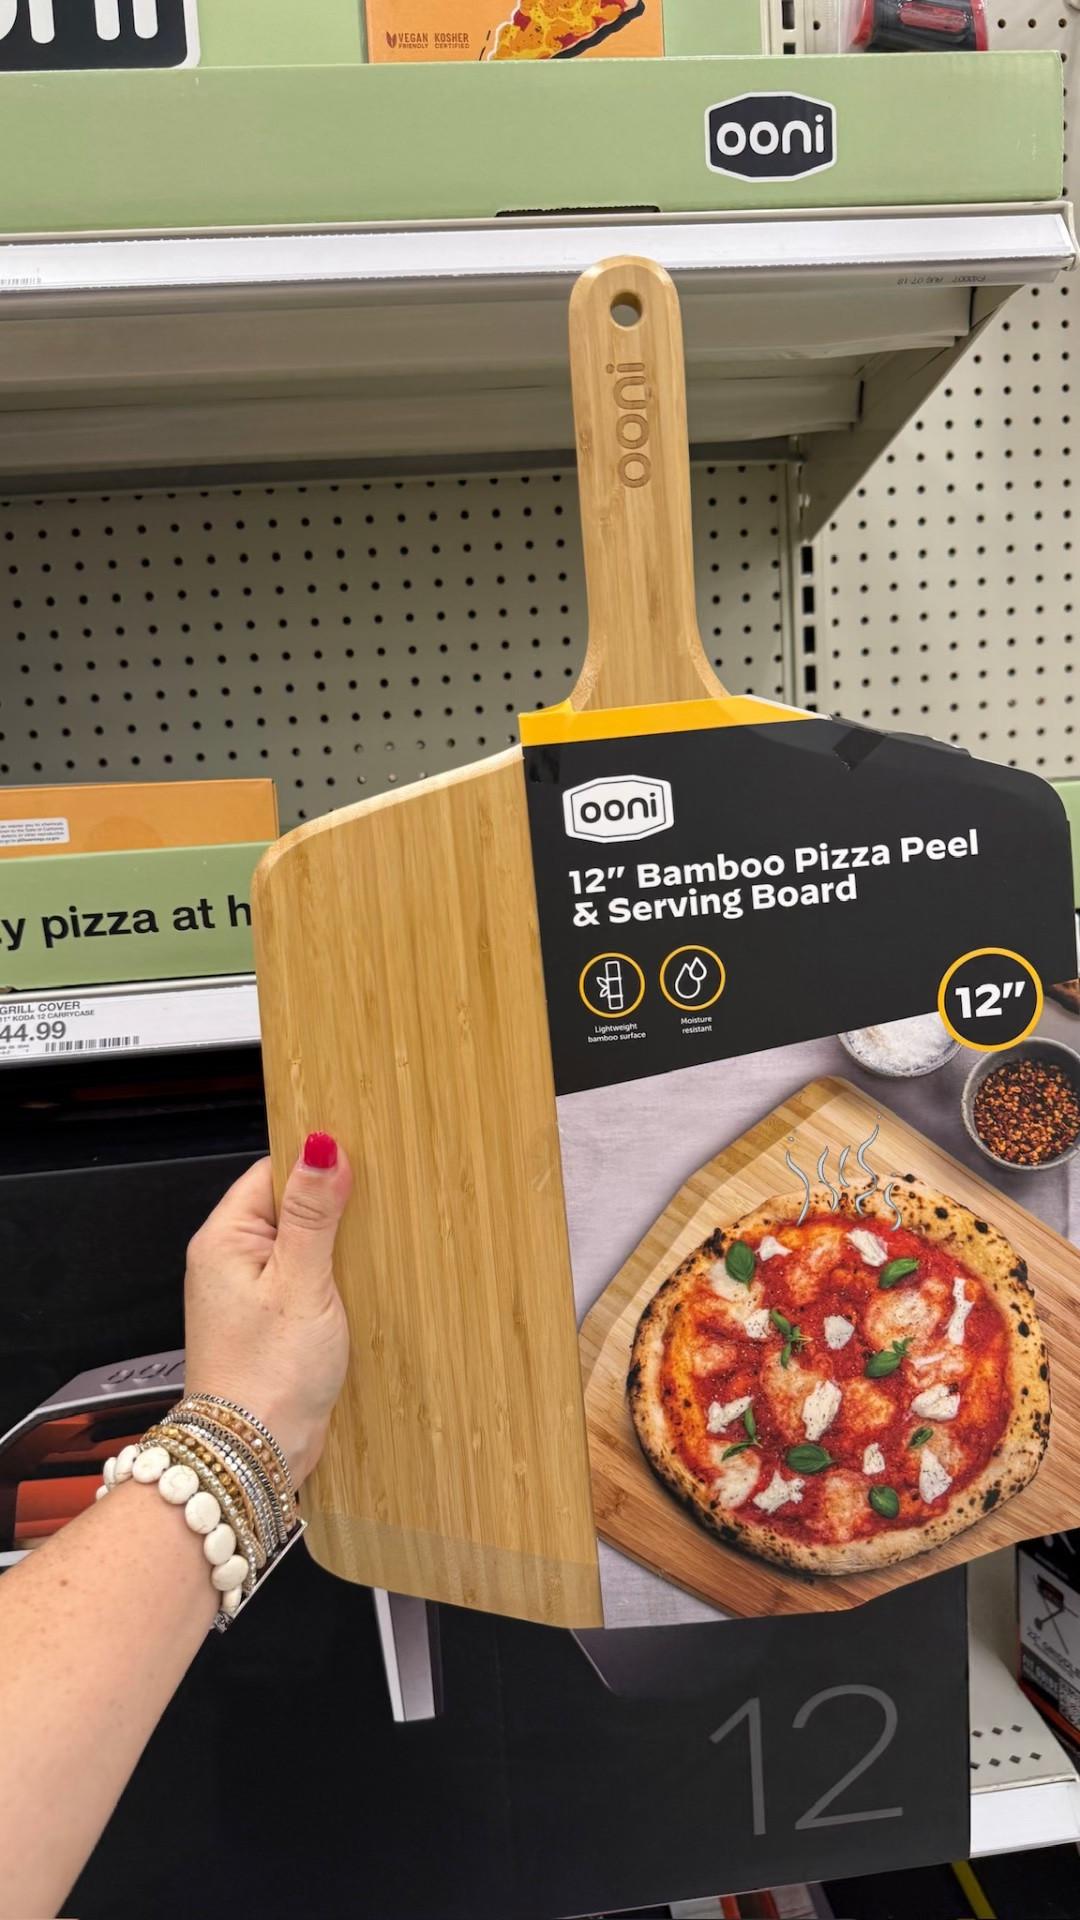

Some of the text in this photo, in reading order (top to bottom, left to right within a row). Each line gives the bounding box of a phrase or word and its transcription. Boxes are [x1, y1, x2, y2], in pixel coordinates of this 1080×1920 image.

[398, 33, 429, 43] VEGAN
[434, 33, 469, 43] KOSHER
[716, 114, 825, 156] ooni
[605, 362, 651, 489] ooni
[580, 792, 659, 824] ooni
[568, 828, 979, 895] 12" Bamboo Pizza Peel
[572, 873, 858, 927] & Serving Board
[0, 917, 26, 951] y
[41, 905, 159, 949] pizza
[172, 898, 216, 931] at
[0, 1000, 81, 1016] GRILL COVER
[954, 980, 1026, 1019] 12"
[12, 1014, 36, 1022] KODA
[47, 1009, 95, 1019] CARRYCASE
[680, 1016, 713, 1025] Moisture
[588, 1031, 647, 1043] bamboo surface
[594, 1022, 638, 1034] Lightweight
[681, 1025, 713, 1034] resistant
[708, 1684, 904, 1836] 12
